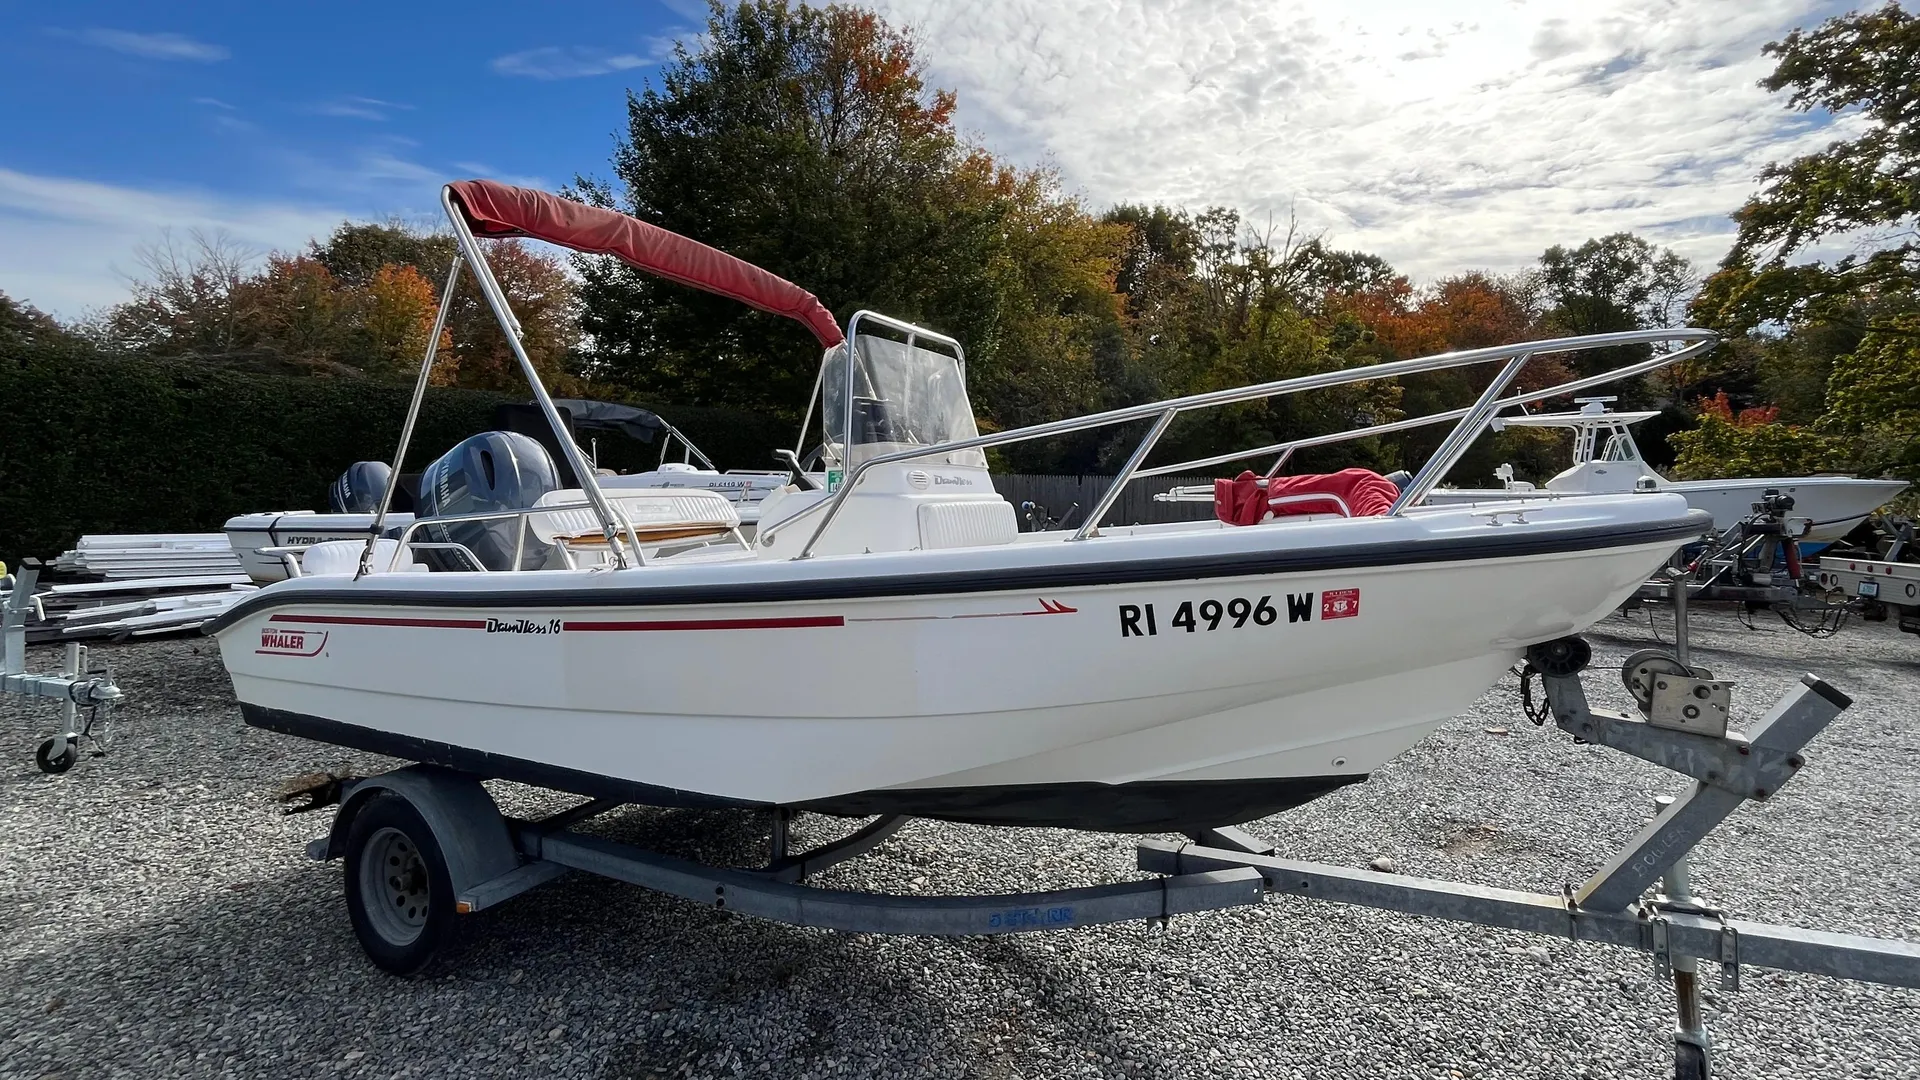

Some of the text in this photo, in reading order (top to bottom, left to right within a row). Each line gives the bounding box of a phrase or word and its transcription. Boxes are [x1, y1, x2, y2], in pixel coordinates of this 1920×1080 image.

[1323, 600, 1358, 612] 2 7
[1119, 592, 1314, 638] RI 4996 W
[487, 617, 561, 635] Dauntless 16
[261, 634, 304, 650] WHALER
